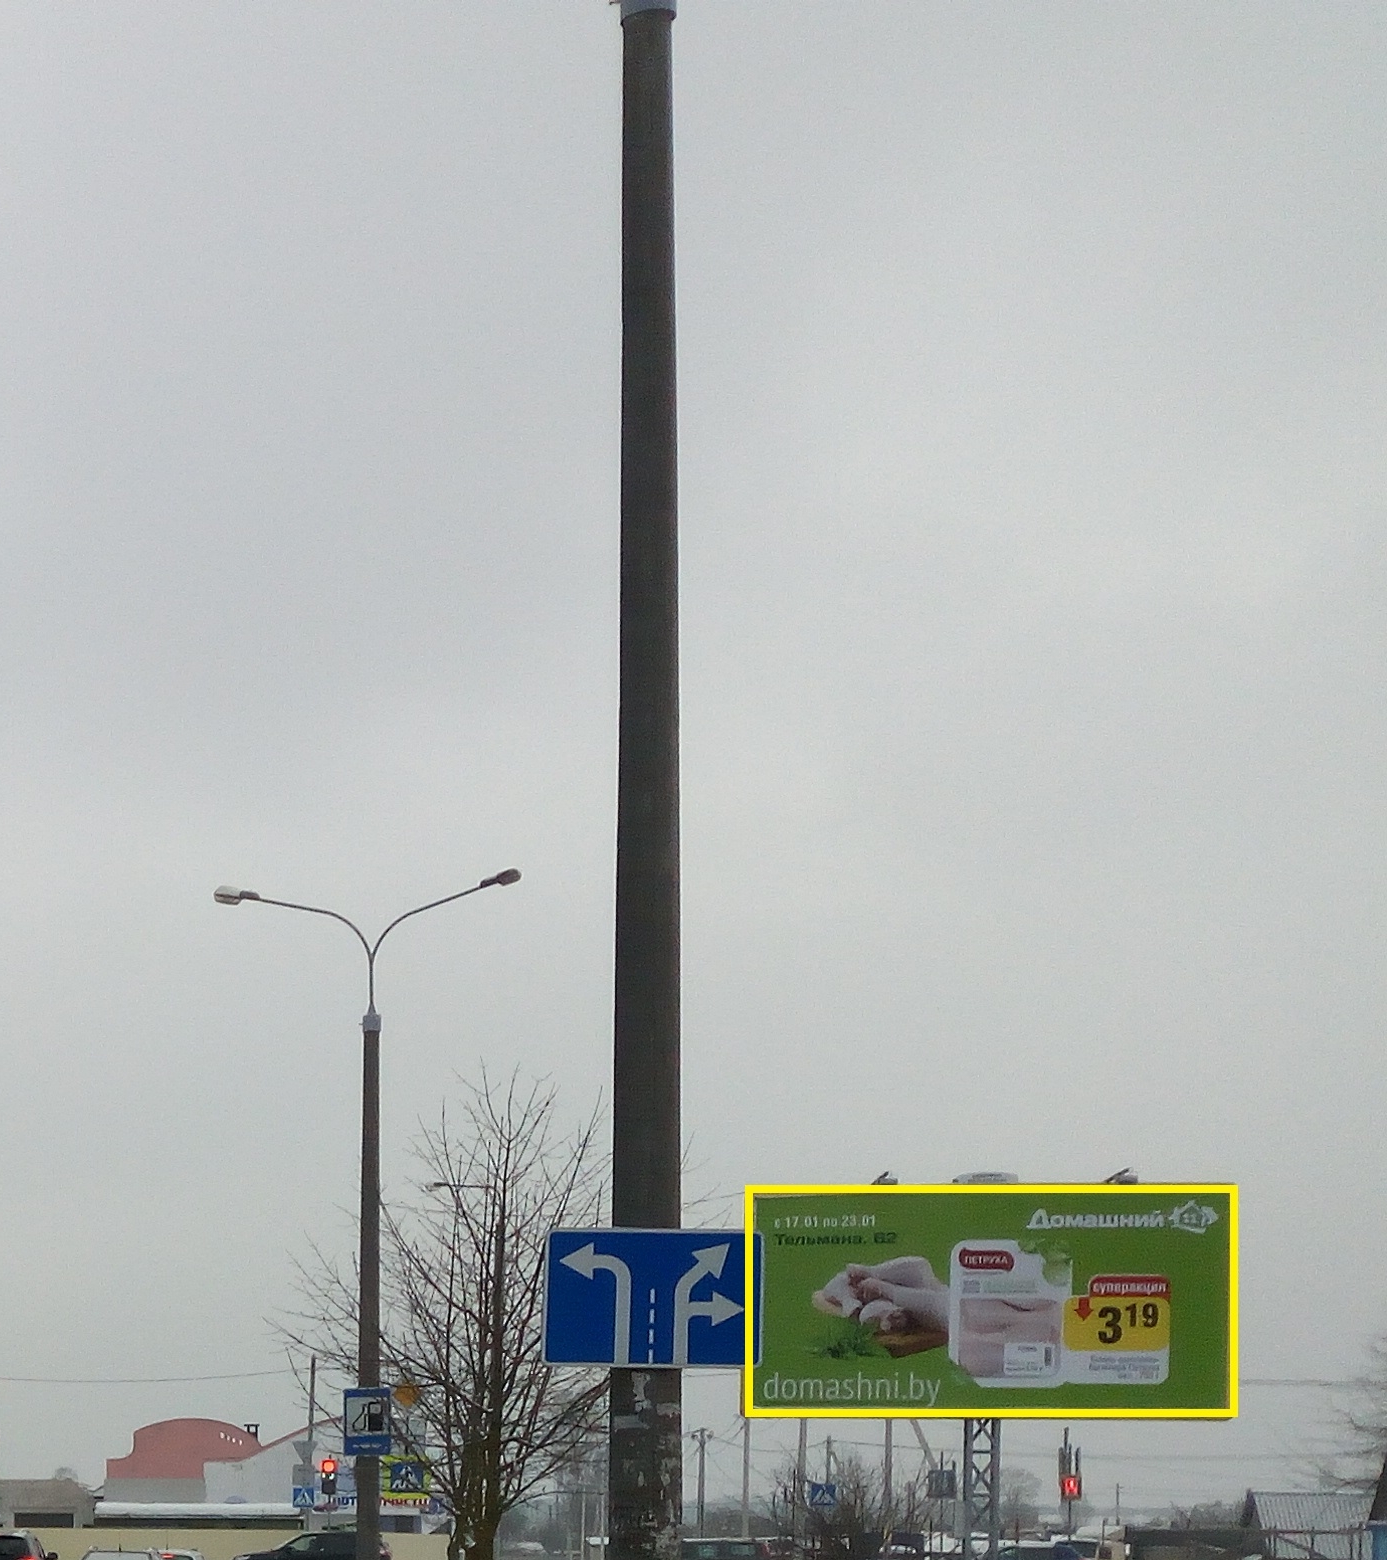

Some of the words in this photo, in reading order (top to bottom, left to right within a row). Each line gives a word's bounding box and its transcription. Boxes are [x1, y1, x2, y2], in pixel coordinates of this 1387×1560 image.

[841, 1214, 876, 1227] 23.01
[1026, 1207, 1165, 1230] Домашний
[964, 1255, 1008, 1265] ПЕТРУХА
[1092, 1282, 1166, 1295] суперакция
[763, 1371, 941, 1407] domashni.by
